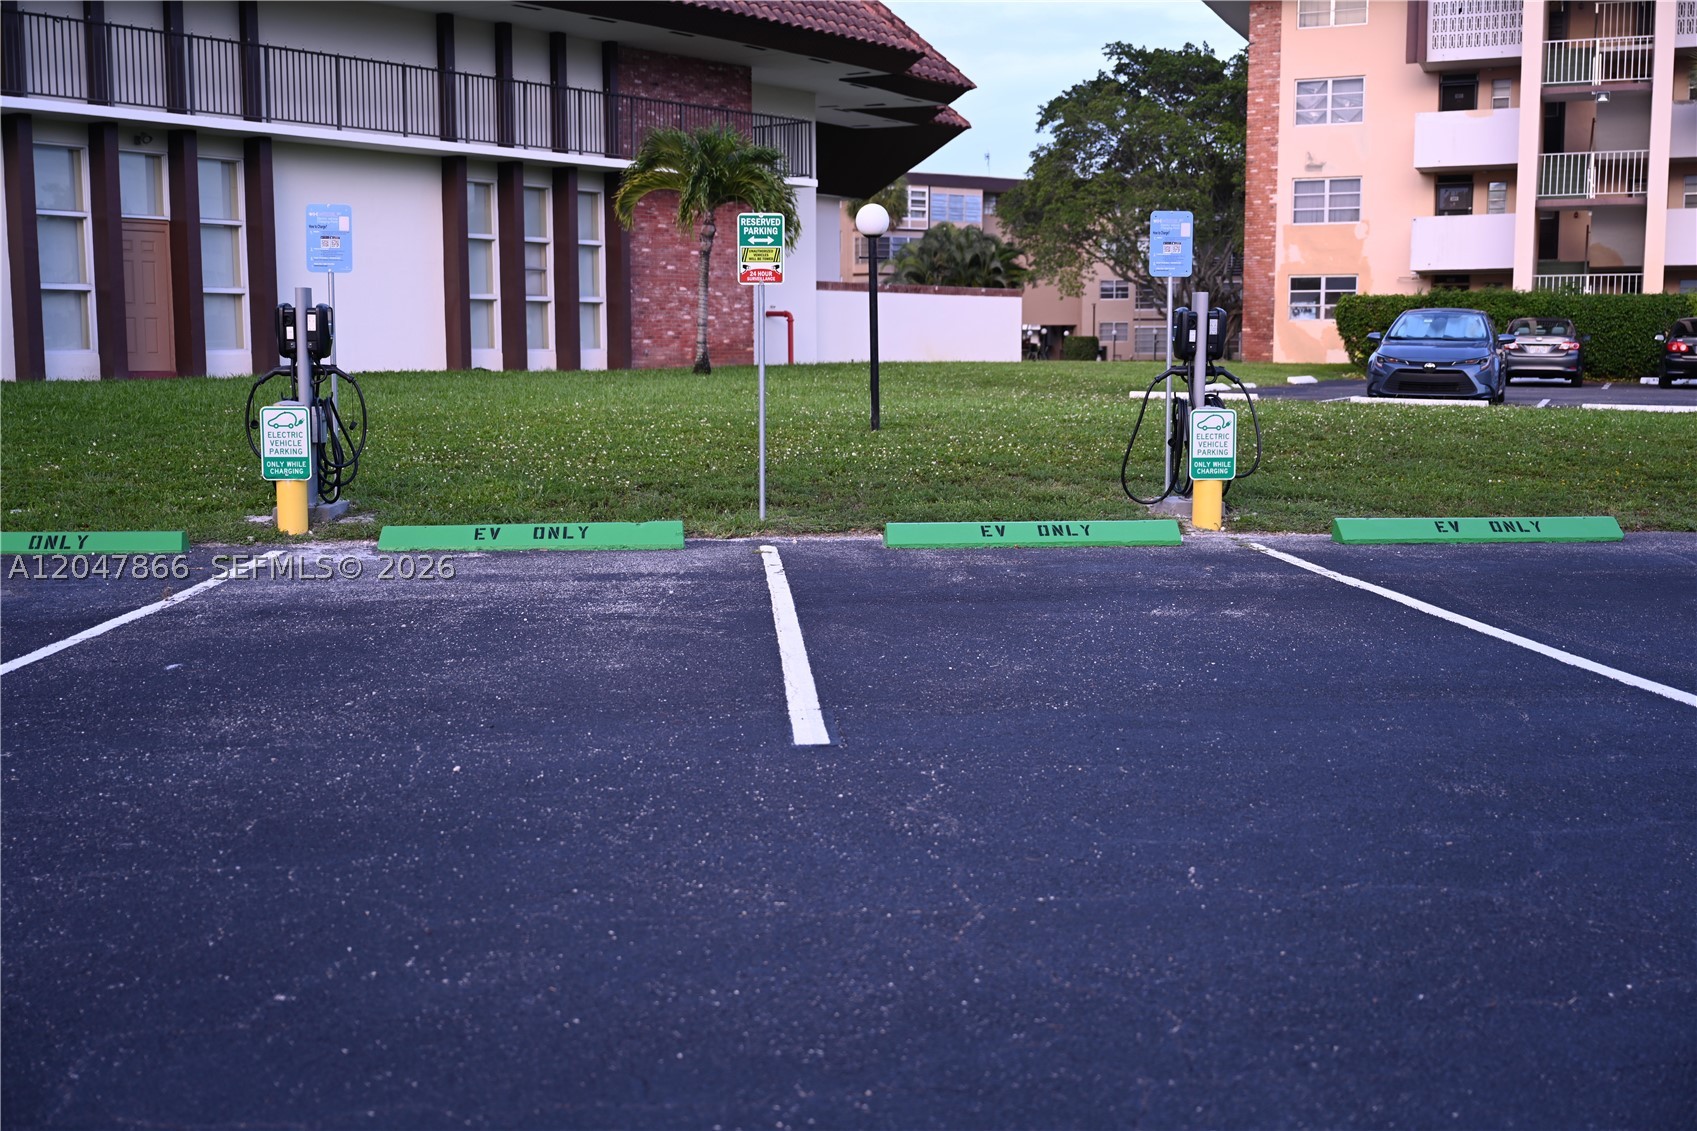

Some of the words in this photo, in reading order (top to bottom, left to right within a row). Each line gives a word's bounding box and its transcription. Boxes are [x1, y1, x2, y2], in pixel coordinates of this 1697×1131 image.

[740, 218, 781, 226] RESERVED
[743, 226, 778, 235] PARKING
[980, 525, 1005, 537] EV
[1037, 524, 1090, 536] ONLY
[1434, 521, 1459, 532] EV
[1488, 521, 1541, 532] ONLY
[474, 527, 501, 540] EV
[533, 526, 589, 540] ONLY
[28, 534, 90, 551] ONLY
